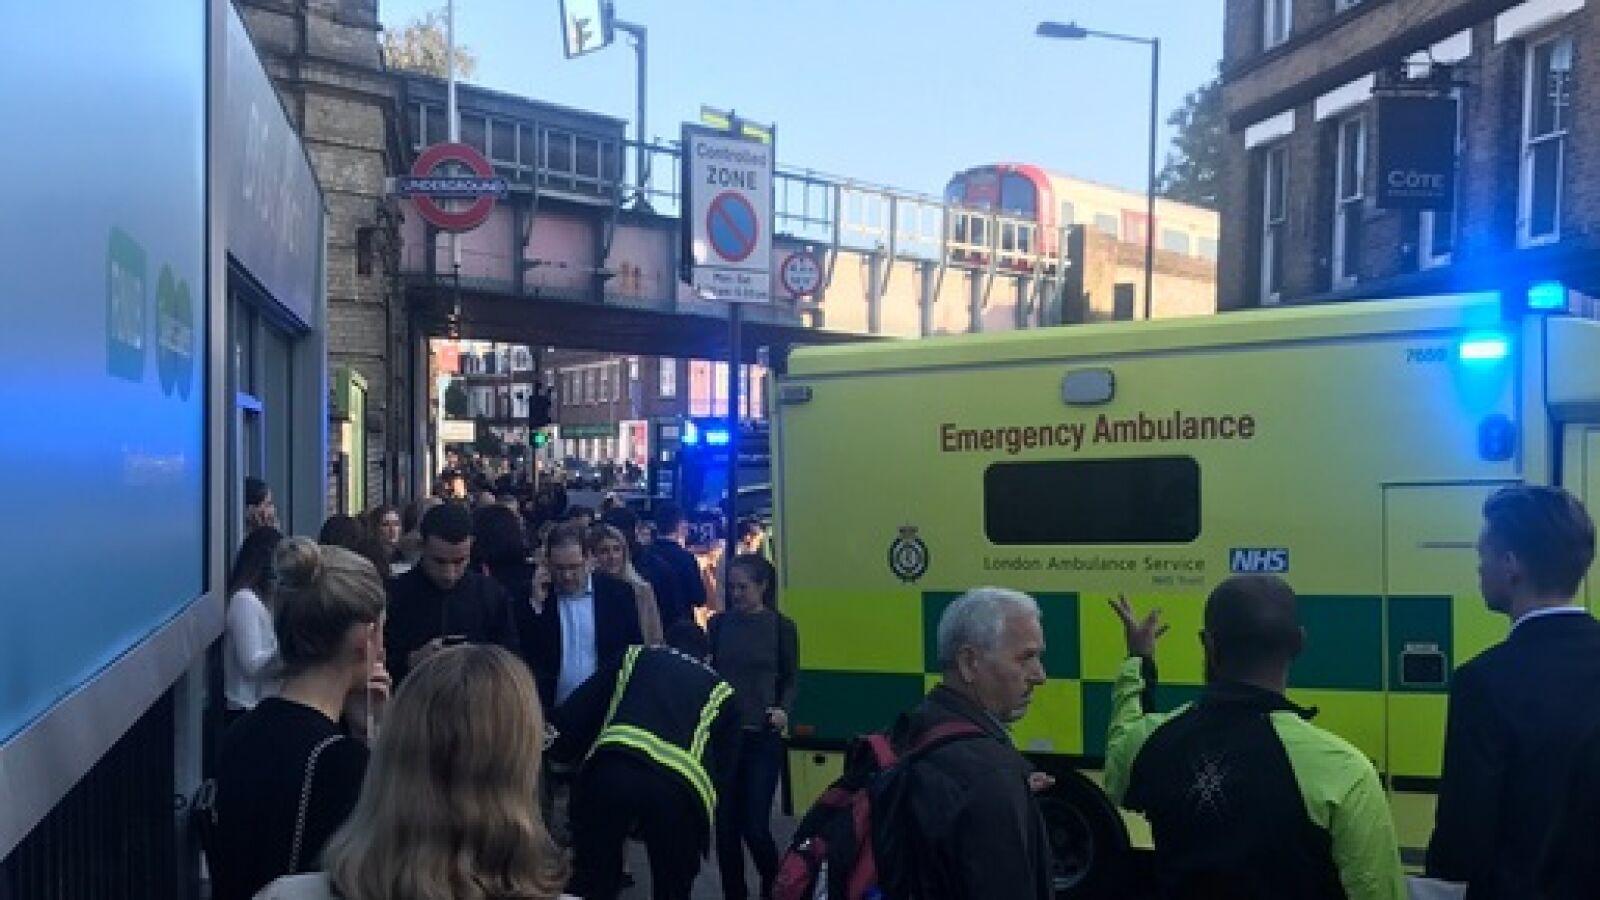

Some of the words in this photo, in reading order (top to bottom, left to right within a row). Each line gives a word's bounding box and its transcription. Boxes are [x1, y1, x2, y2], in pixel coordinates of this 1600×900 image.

[696, 142, 768, 168] Controlled
[402, 179, 503, 194] UNDERGROUND
[706, 164, 757, 191] ZONE
[940, 422, 1086, 455] Emergency
[1092, 410, 1256, 443] Ambulance
[983, 556, 1042, 571] London
[1046, 555, 1137, 571] Ambulance
[1143, 555, 1206, 571] Service
[1232, 550, 1287, 570] NHS
